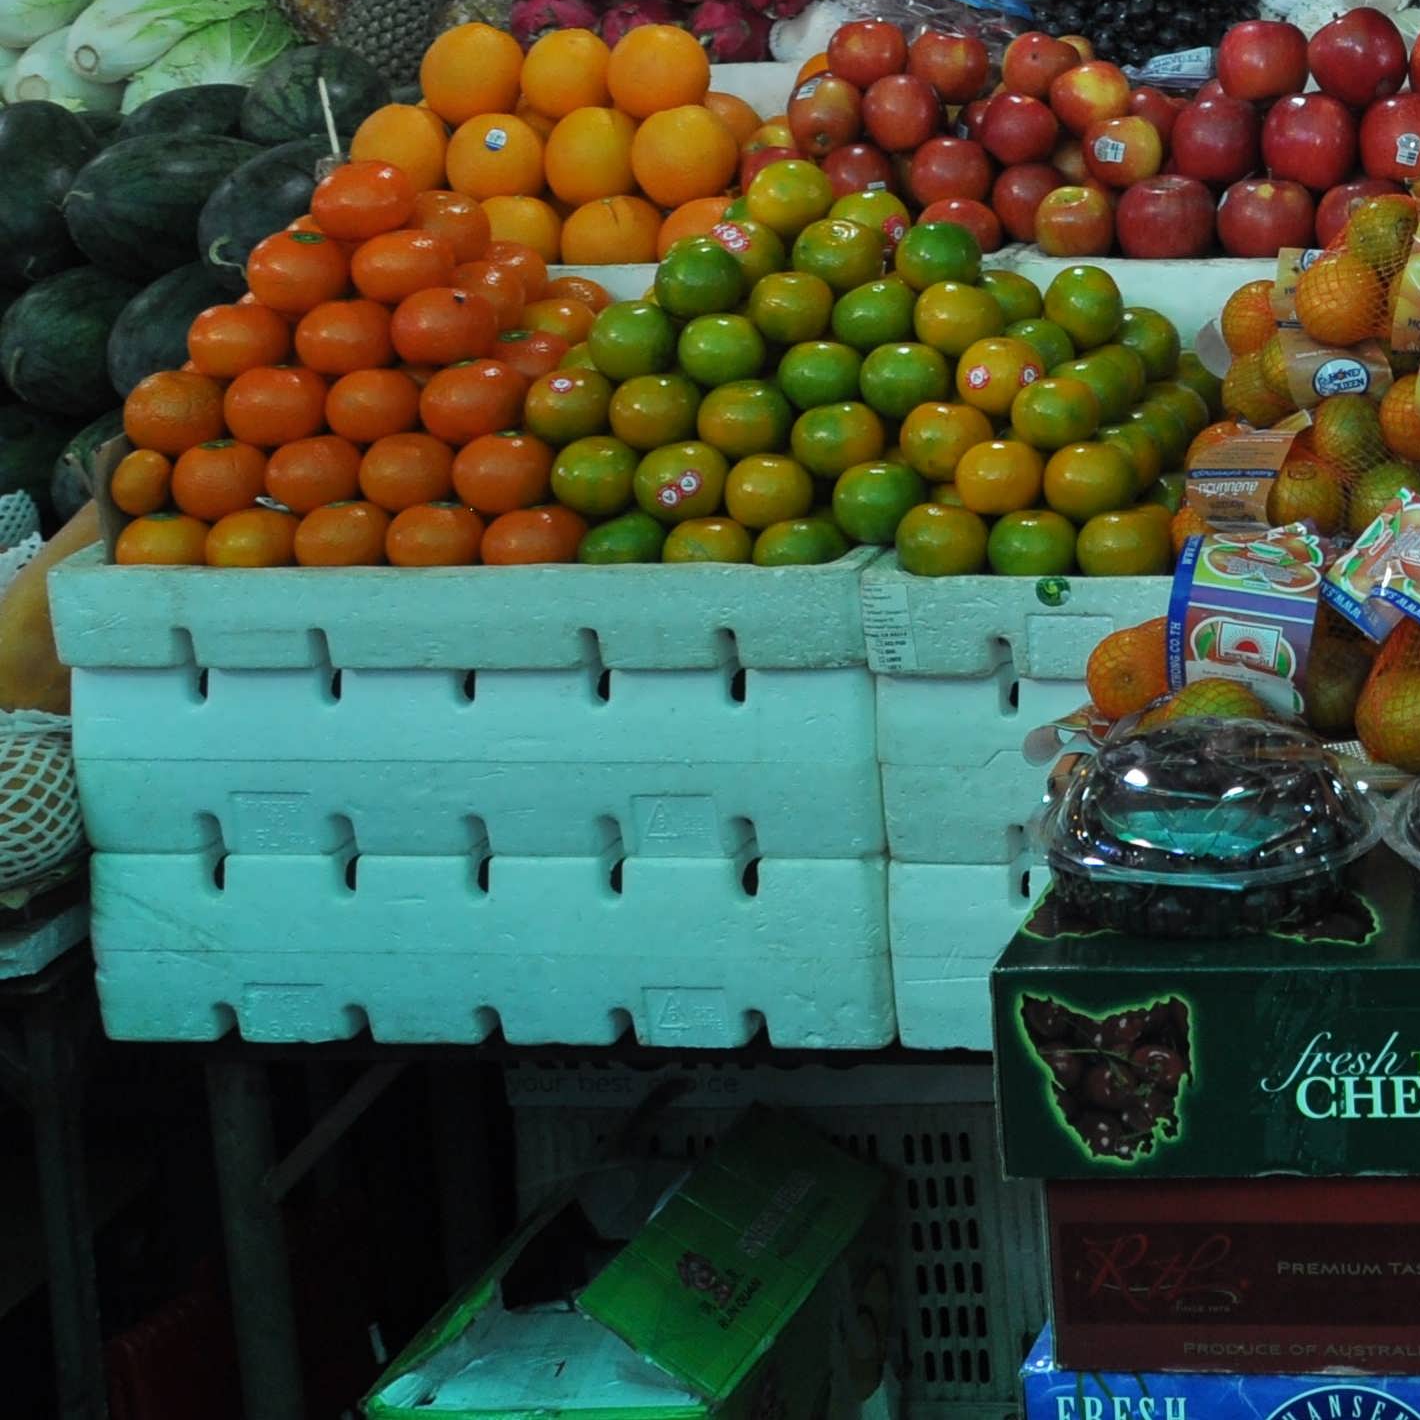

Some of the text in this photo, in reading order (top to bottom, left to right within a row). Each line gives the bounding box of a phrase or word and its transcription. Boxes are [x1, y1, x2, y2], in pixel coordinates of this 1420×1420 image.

[1261, 1031, 1403, 1093] fresh
[1277, 1261, 1383, 1276] PREMIUM
[1183, 1341, 1282, 1358] PRODUCE
[1289, 1343, 1317, 1358] OF
